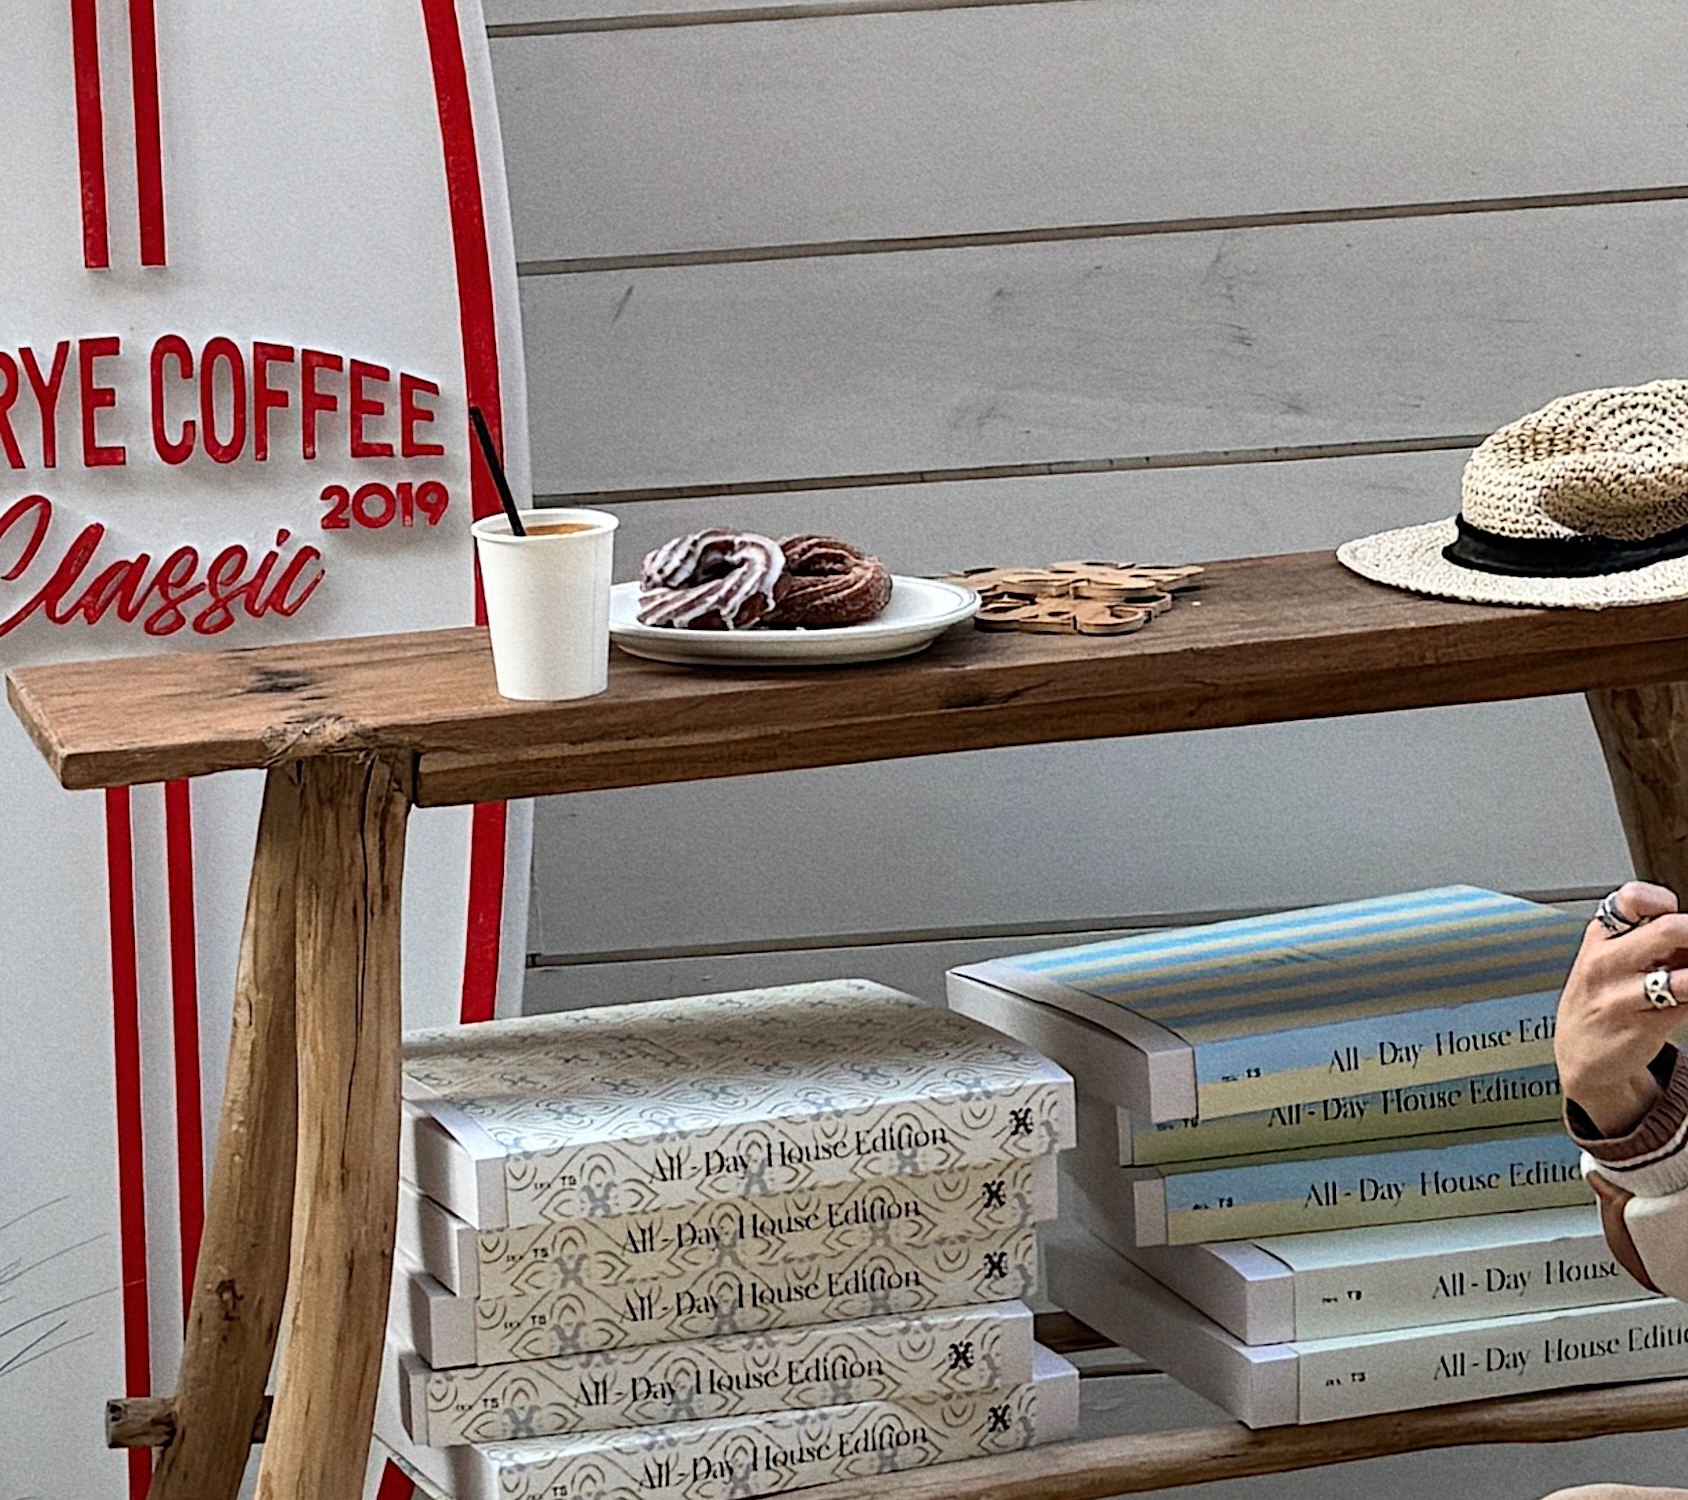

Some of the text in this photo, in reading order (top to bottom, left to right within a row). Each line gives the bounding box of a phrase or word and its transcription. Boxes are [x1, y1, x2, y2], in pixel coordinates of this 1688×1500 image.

[150, 334, 444, 466] COFFEE
[320, 480, 449, 530] 2019
[1435, 1030, 1511, 1057] House
[1382, 1087, 1462, 1115] House
[765, 1137, 849, 1168] House
[856, 1124, 948, 1156] Edition
[1421, 1171, 1500, 1197] House
[738, 1209, 820, 1240] House
[827, 1198, 921, 1229] Edition
[737, 1278, 820, 1308] House
[827, 1267, 921, 1298] Edition
[1544, 1336, 1620, 1364] House
[695, 1364, 780, 1396] House
[787, 1355, 884, 1385] Edition
[751, 1438, 832, 1471] House
[838, 1424, 928, 1458] Edition
